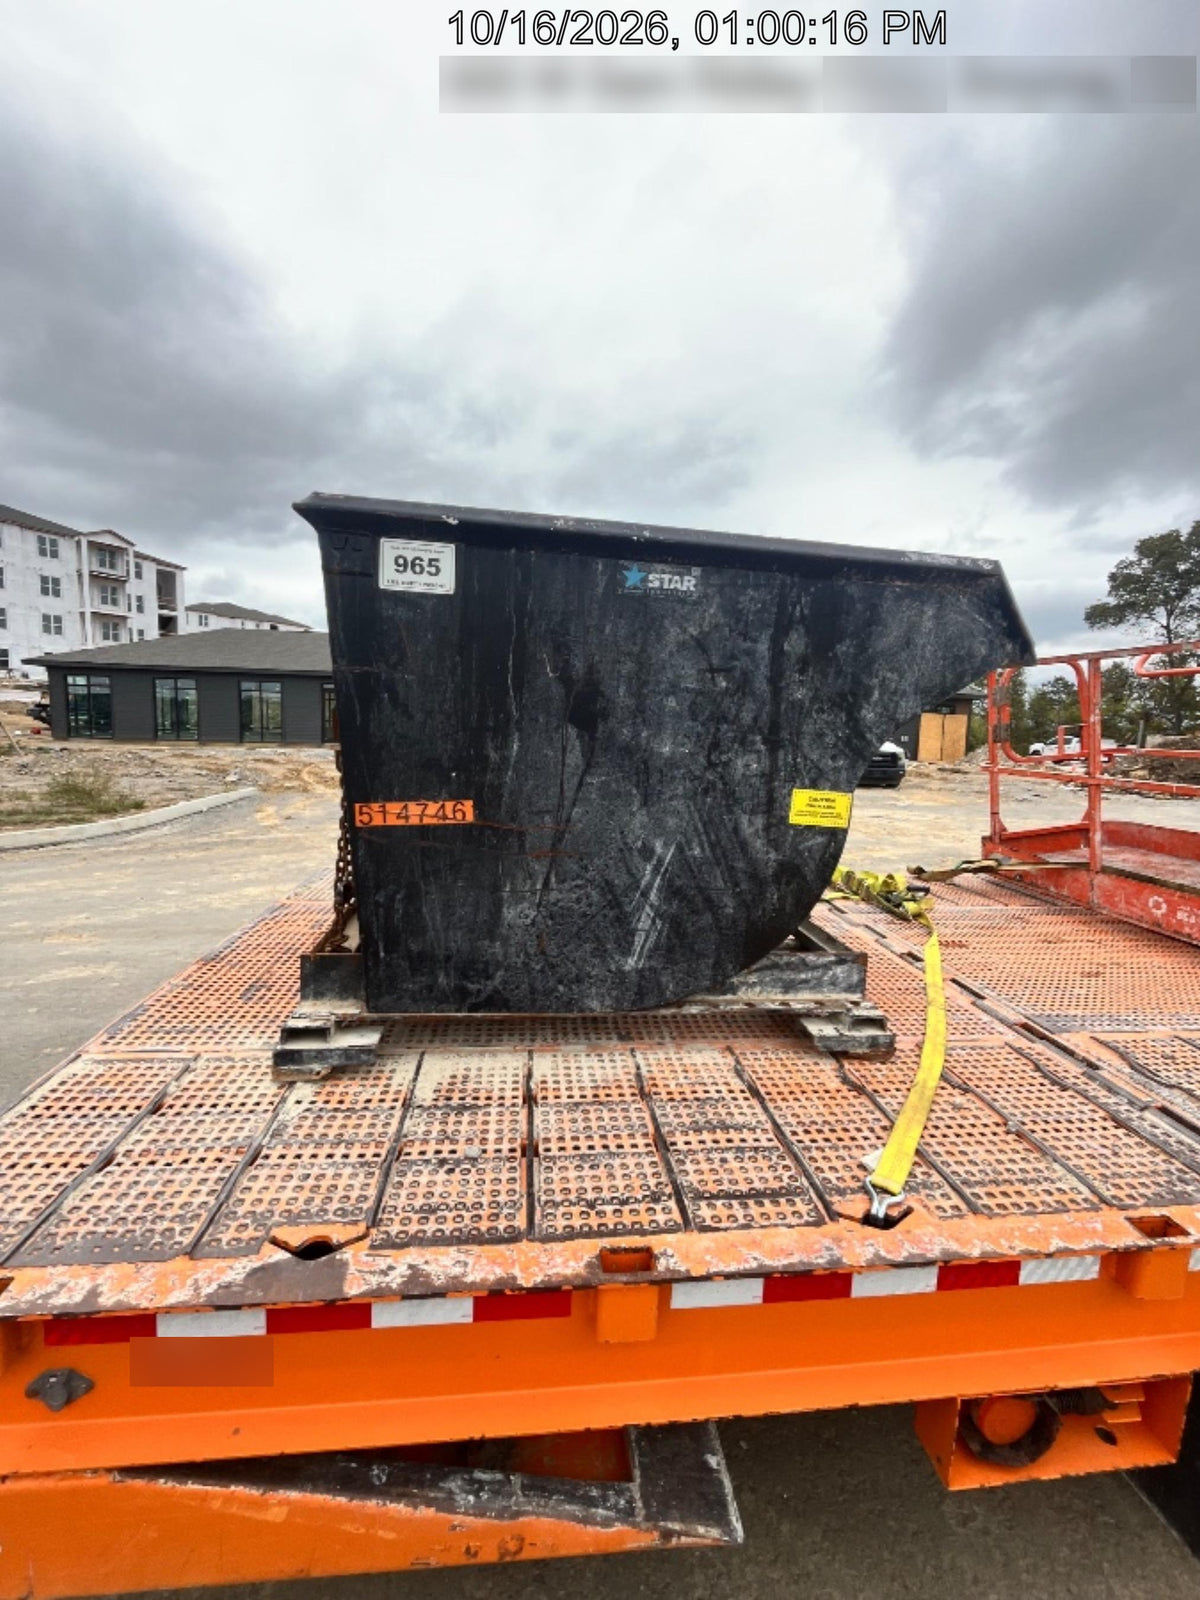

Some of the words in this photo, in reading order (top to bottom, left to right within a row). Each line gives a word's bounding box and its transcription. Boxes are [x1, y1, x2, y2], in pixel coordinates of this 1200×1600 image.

[394, 554, 442, 577] 965
[647, 573, 697, 591] STAR
[358, 801, 467, 825] 514746
